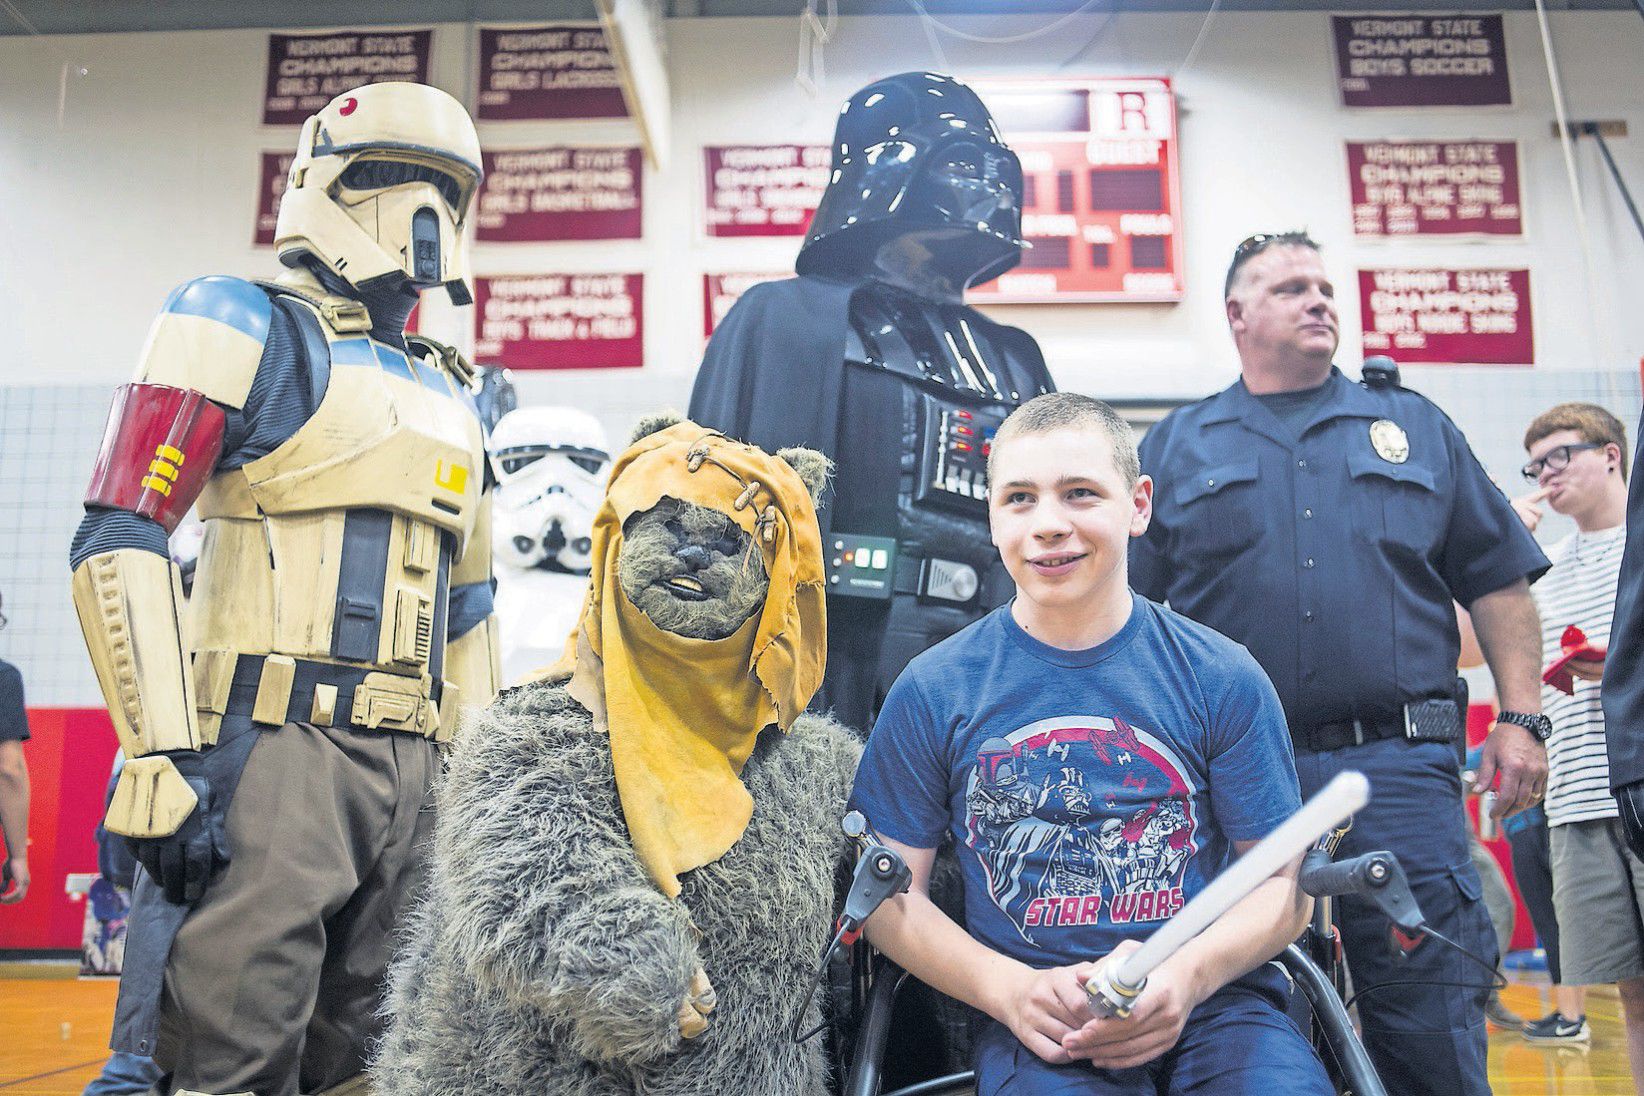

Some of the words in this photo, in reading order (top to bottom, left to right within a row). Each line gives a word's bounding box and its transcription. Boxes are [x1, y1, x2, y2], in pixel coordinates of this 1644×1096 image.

[1352, 19, 1424, 36] VERMONT
[1431, 19, 1483, 35] STATE
[362, 35, 415, 54] STATE
[1348, 38, 1491, 55] CHAMPIONS
[279, 54, 418, 76] CHAMPIONS
[1350, 58, 1406, 76] BOYS
[1410, 57, 1495, 75] SOCCER
[1117, 91, 1149, 131] R
[573, 151, 627, 170] STATE
[1364, 144, 1439, 163] VERMONT
[1444, 144, 1497, 163] STATE
[487, 169, 633, 191] CHAMPIONS
[1360, 163, 1505, 184] CHAMPIONS
[1456, 271, 1512, 291] STATE
[485, 295, 633, 319] CHAMPIONS
[1370, 291, 1519, 313] CHAMPIONS
[1025, 894, 1102, 927] STAR
[1109, 887, 1186, 924] WARS
